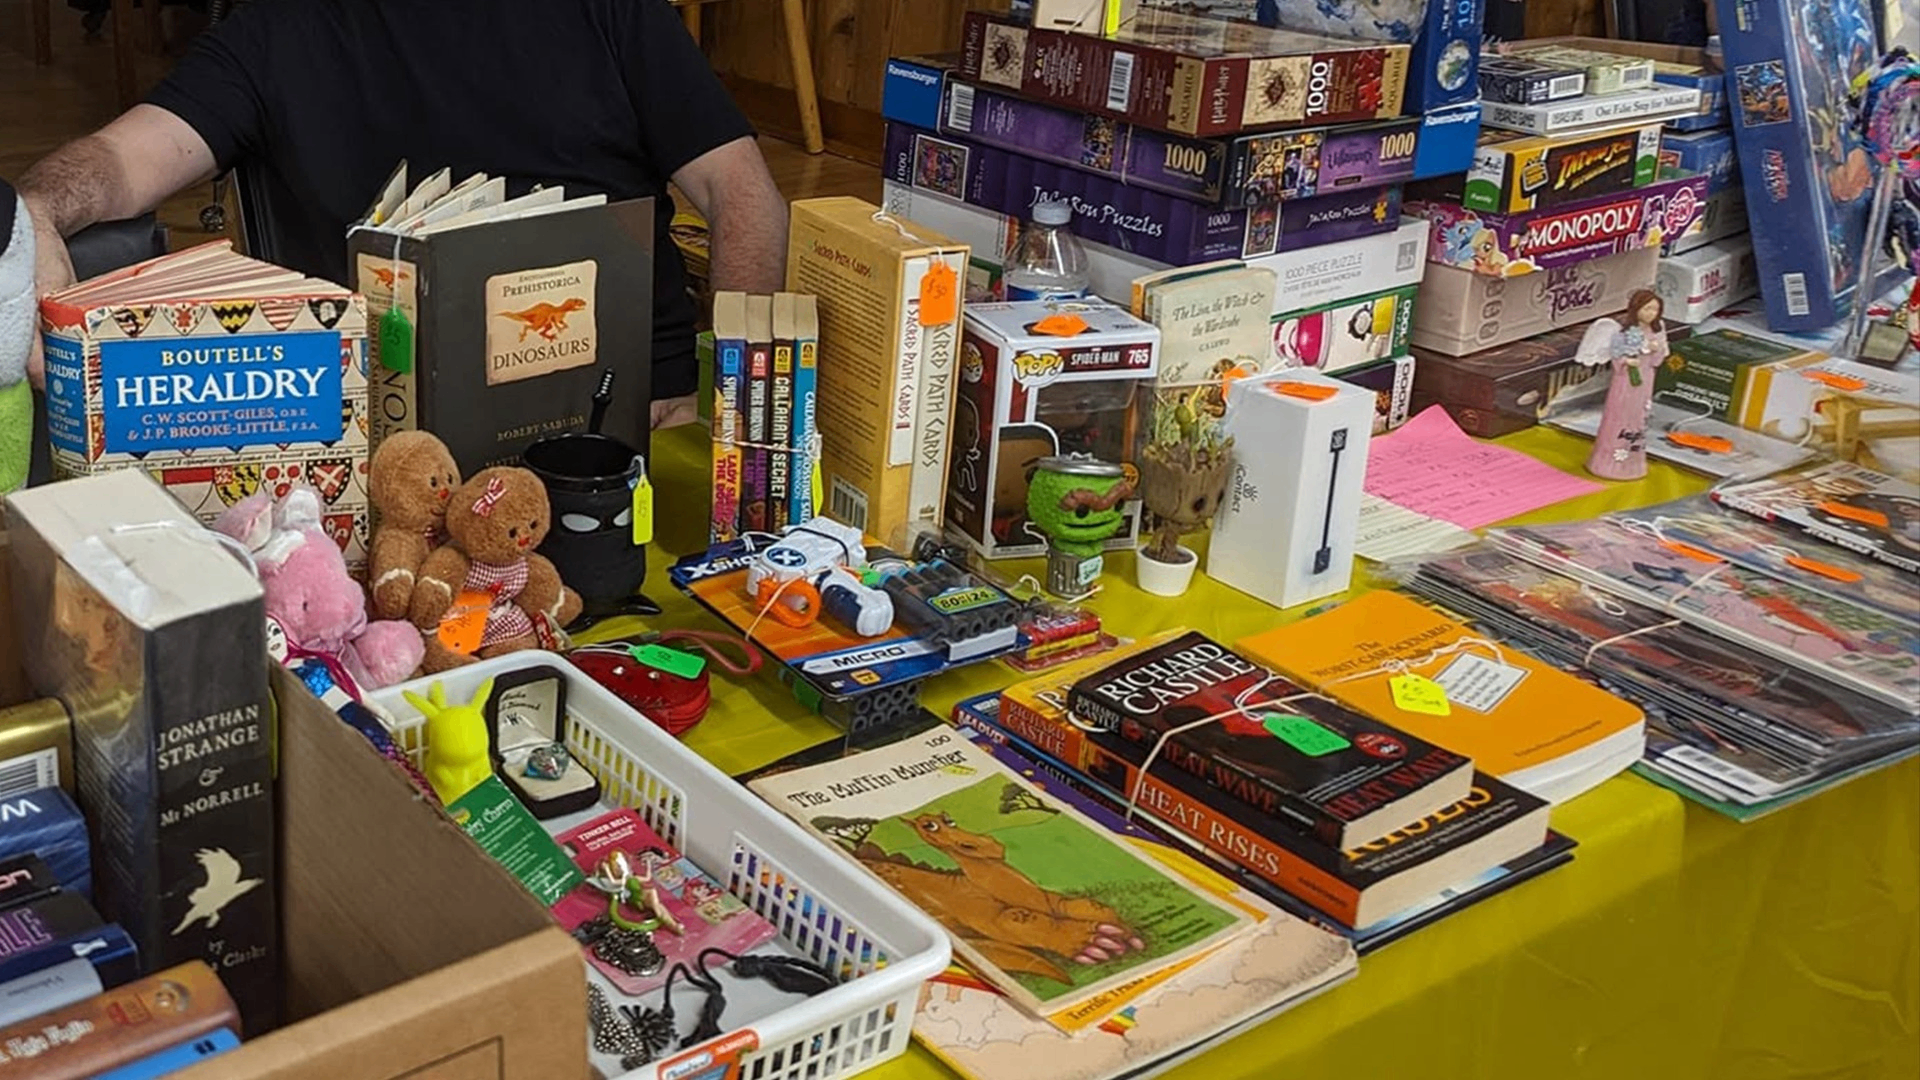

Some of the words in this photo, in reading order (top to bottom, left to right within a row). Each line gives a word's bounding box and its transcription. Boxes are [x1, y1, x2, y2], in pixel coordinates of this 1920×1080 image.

[887, 64, 938, 86] Ravensburger
[1306, 61, 1328, 117] 1000
[1425, 111, 1479, 126] Ravensburger
[1164, 143, 1207, 175] 1000
[1379, 132, 1415, 159] 1000
[897, 152, 907, 182] 1000
[1100, 204, 1163, 236] Puzzles
[1207, 213, 1231, 226] 1000
[1529, 204, 1638, 248] MONOPOLY
[503, 276, 581, 298] PREHISTORICA
[904, 308, 920, 349] SACRED
[161, 345, 285, 367] BOUTELL'S
[493, 337, 591, 370] DINOSAURS
[930, 323, 952, 369] ACRED
[1070, 351, 1121, 366] SPIDER-MAN
[1128, 349, 1149, 365] 765
[901, 352, 917, 381] PATH
[115, 367, 328, 410] HERALDRY
[899, 384, 914, 419] CARDS
[927, 374, 949, 413] PATH
[127, 429, 139, 441] &
[170, 421, 290, 439] BROOKE-LITTLE,
[177, 408, 278, 424] SCOTT-GILES,
[922, 417, 945, 468] CARDS
[717, 458, 726, 481] THE
[727, 454, 737, 484] LADY
[771, 453, 787, 499] SECRET
[832, 646, 906, 667] MICRO
[1354, 640, 1381, 652] The
[1096, 644, 1223, 700] RICHARD
[1123, 654, 1256, 714] CASTLE
[1009, 701, 1067, 741] RICHARD
[1076, 703, 1120, 733] CASTLE
[1077, 694, 1120, 725] RICHARD
[157, 704, 259, 752] JONATHAN
[1006, 713, 1066, 758] CASTLE
[158, 724, 259, 770] STRANGE
[199, 766, 224, 786] &
[787, 791, 831, 808] The
[828, 772, 896, 799] Muffin
[891, 750, 967, 781] Muncher
[1164, 740, 1211, 778] HEAT
[1215, 766, 1275, 813] WAVE
[1324, 780, 1396, 820] HEAT
[1383, 748, 1460, 788] WAVE
[183, 782, 264, 817] NORRELL
[1140, 781, 1205, 830] HEAT
[1210, 821, 1280, 875] RISES
